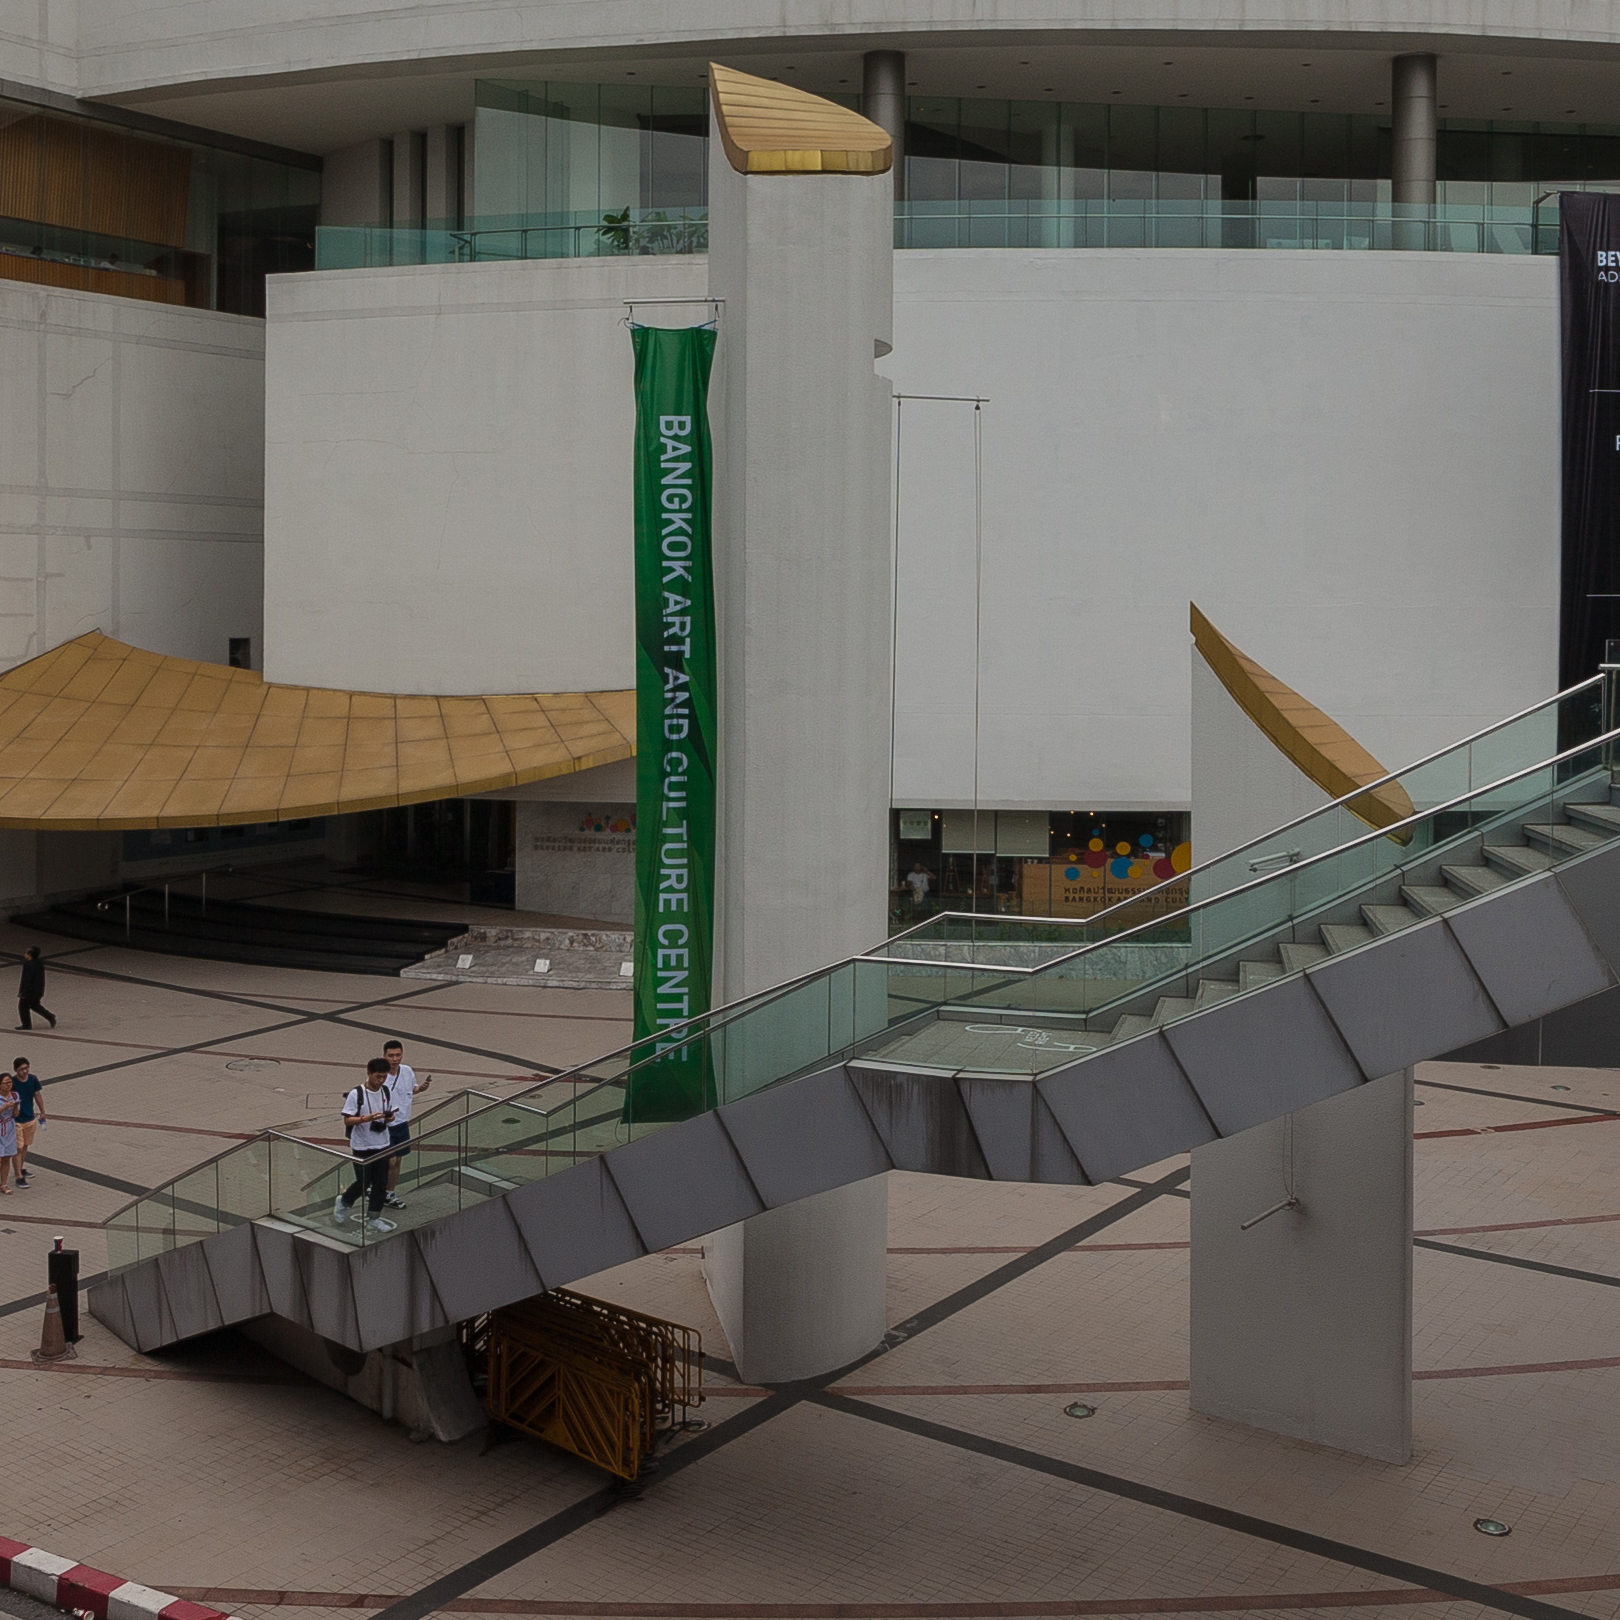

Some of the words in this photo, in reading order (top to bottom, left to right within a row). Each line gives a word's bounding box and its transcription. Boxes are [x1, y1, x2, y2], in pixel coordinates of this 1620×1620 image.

[659, 415, 692, 584] BANGKOK
[662, 590, 691, 658] ART
[663, 666, 690, 740] AND
[658, 751, 688, 913] CULTURE
